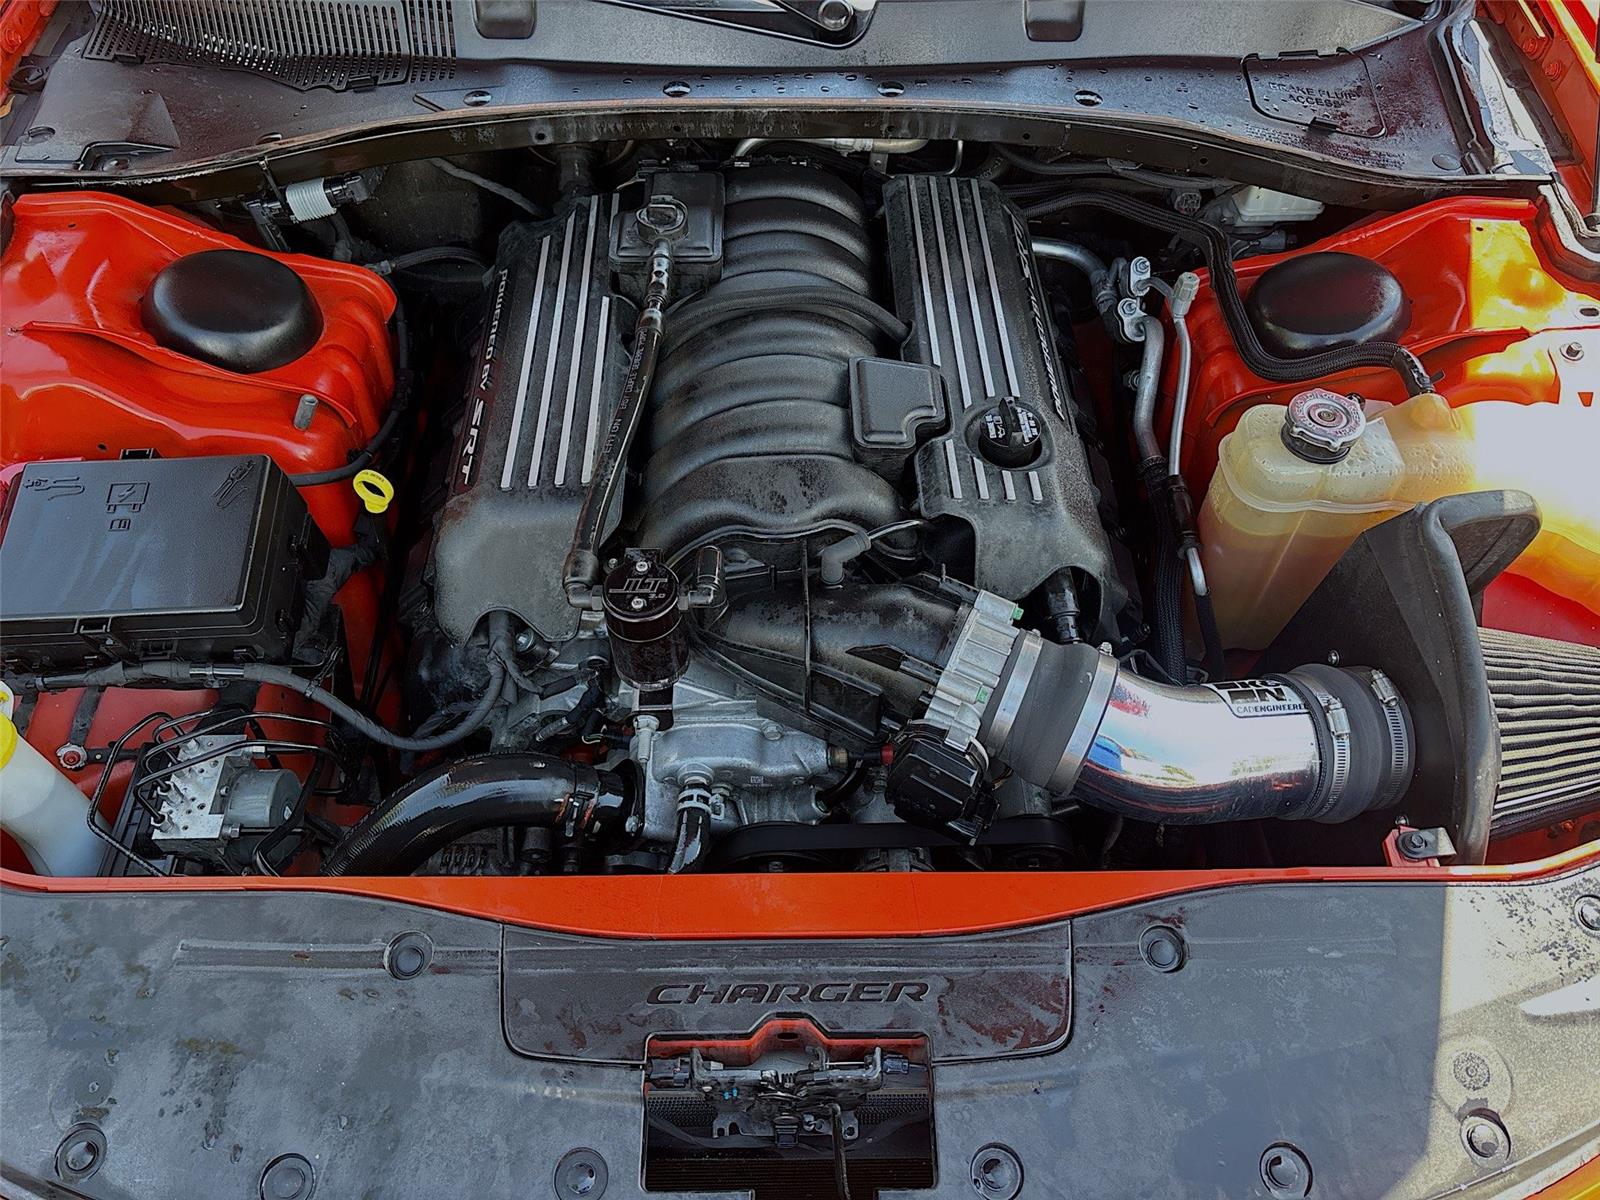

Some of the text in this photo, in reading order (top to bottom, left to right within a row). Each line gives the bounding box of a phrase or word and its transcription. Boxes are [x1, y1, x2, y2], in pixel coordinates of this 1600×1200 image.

[1268, 82, 1360, 101] BRAKE FLUID
[1288, 94, 1342, 109] ACCESS
[486, 268, 508, 360] POWERED
[462, 398, 484, 485] SRT
[608, 578, 668, 594] JLT
[646, 982, 930, 1005] CHARGER
